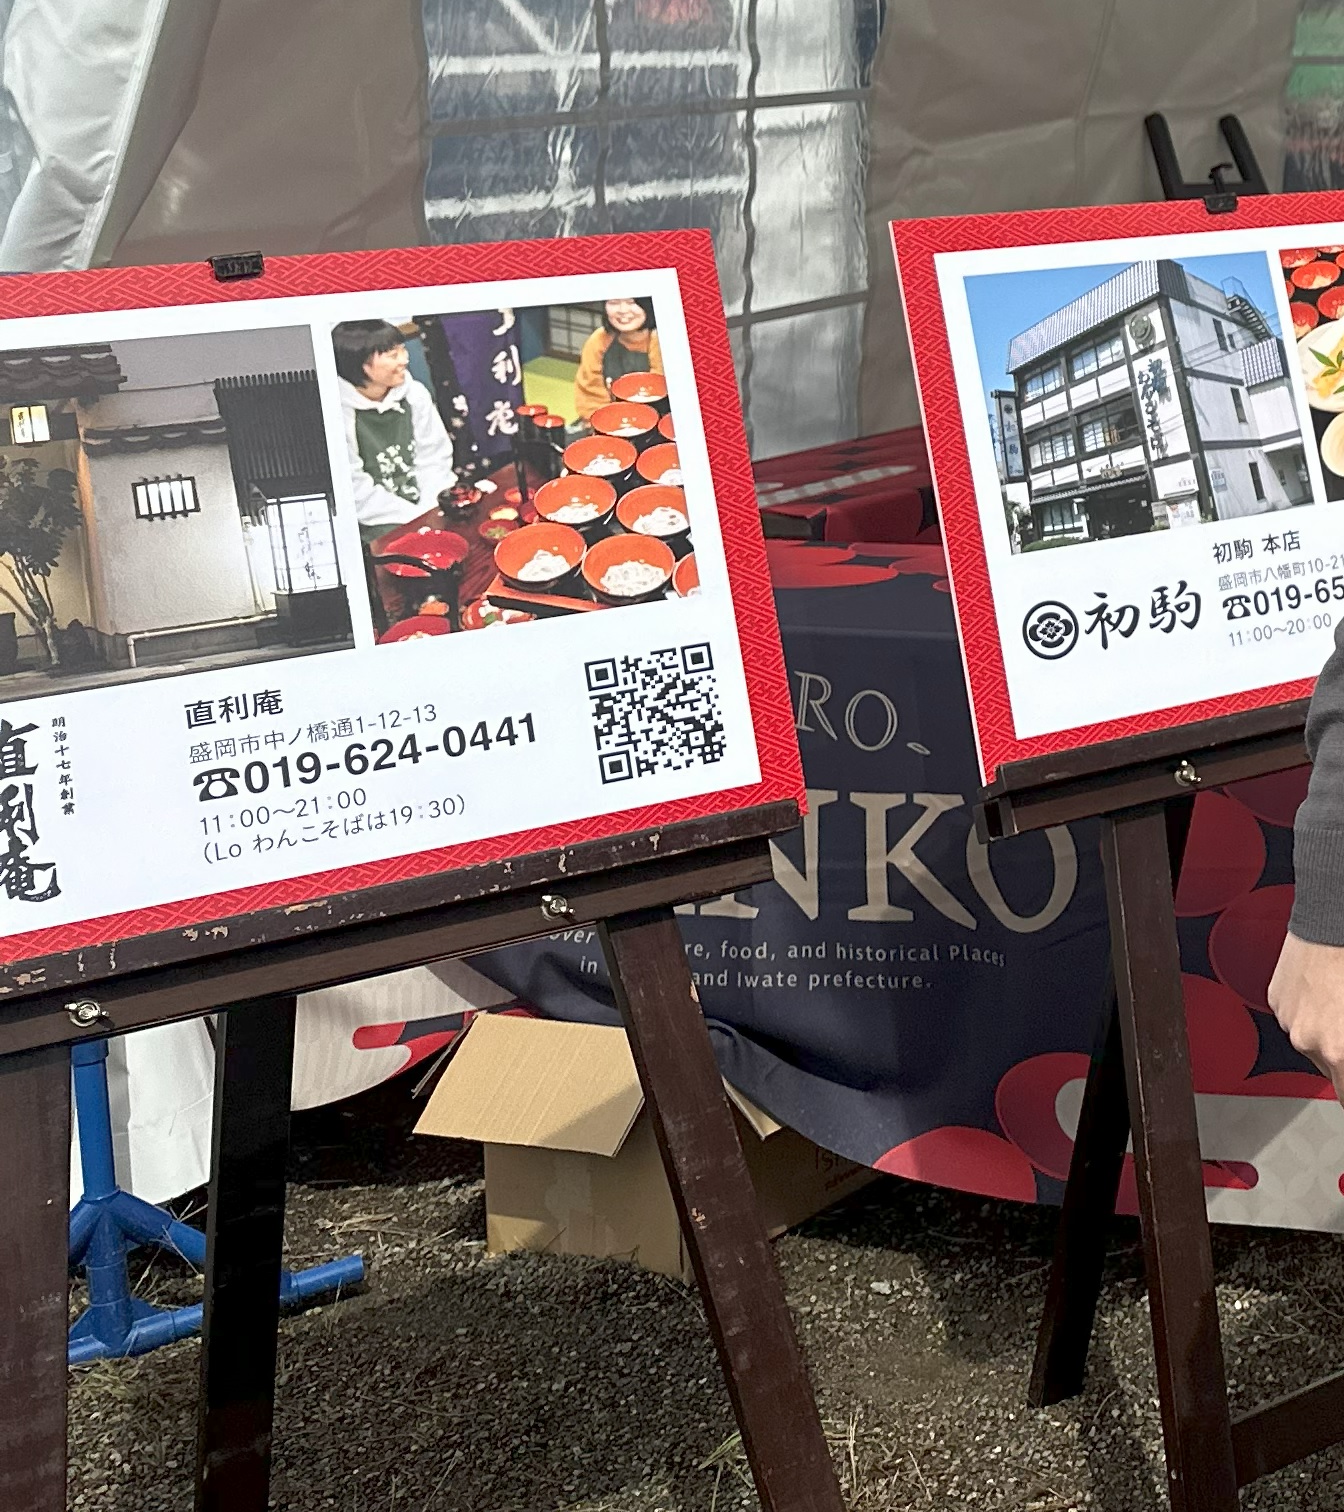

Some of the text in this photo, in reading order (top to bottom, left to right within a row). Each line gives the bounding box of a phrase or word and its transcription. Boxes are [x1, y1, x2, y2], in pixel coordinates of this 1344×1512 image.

[1212, 530, 1302, 565] 初駒 本店
[1084, 580, 1202, 650] 初駒
[183, 688, 285, 730] 直利庵
[244, 712, 537, 794] 019-624-0441
[579, 955, 934, 991] in and Iwate prefecture.
[720, 940, 777, 961] food,
[787, 941, 827, 960] and
[836, 941, 940, 963] historical
[949, 944, 1006, 968] Places
